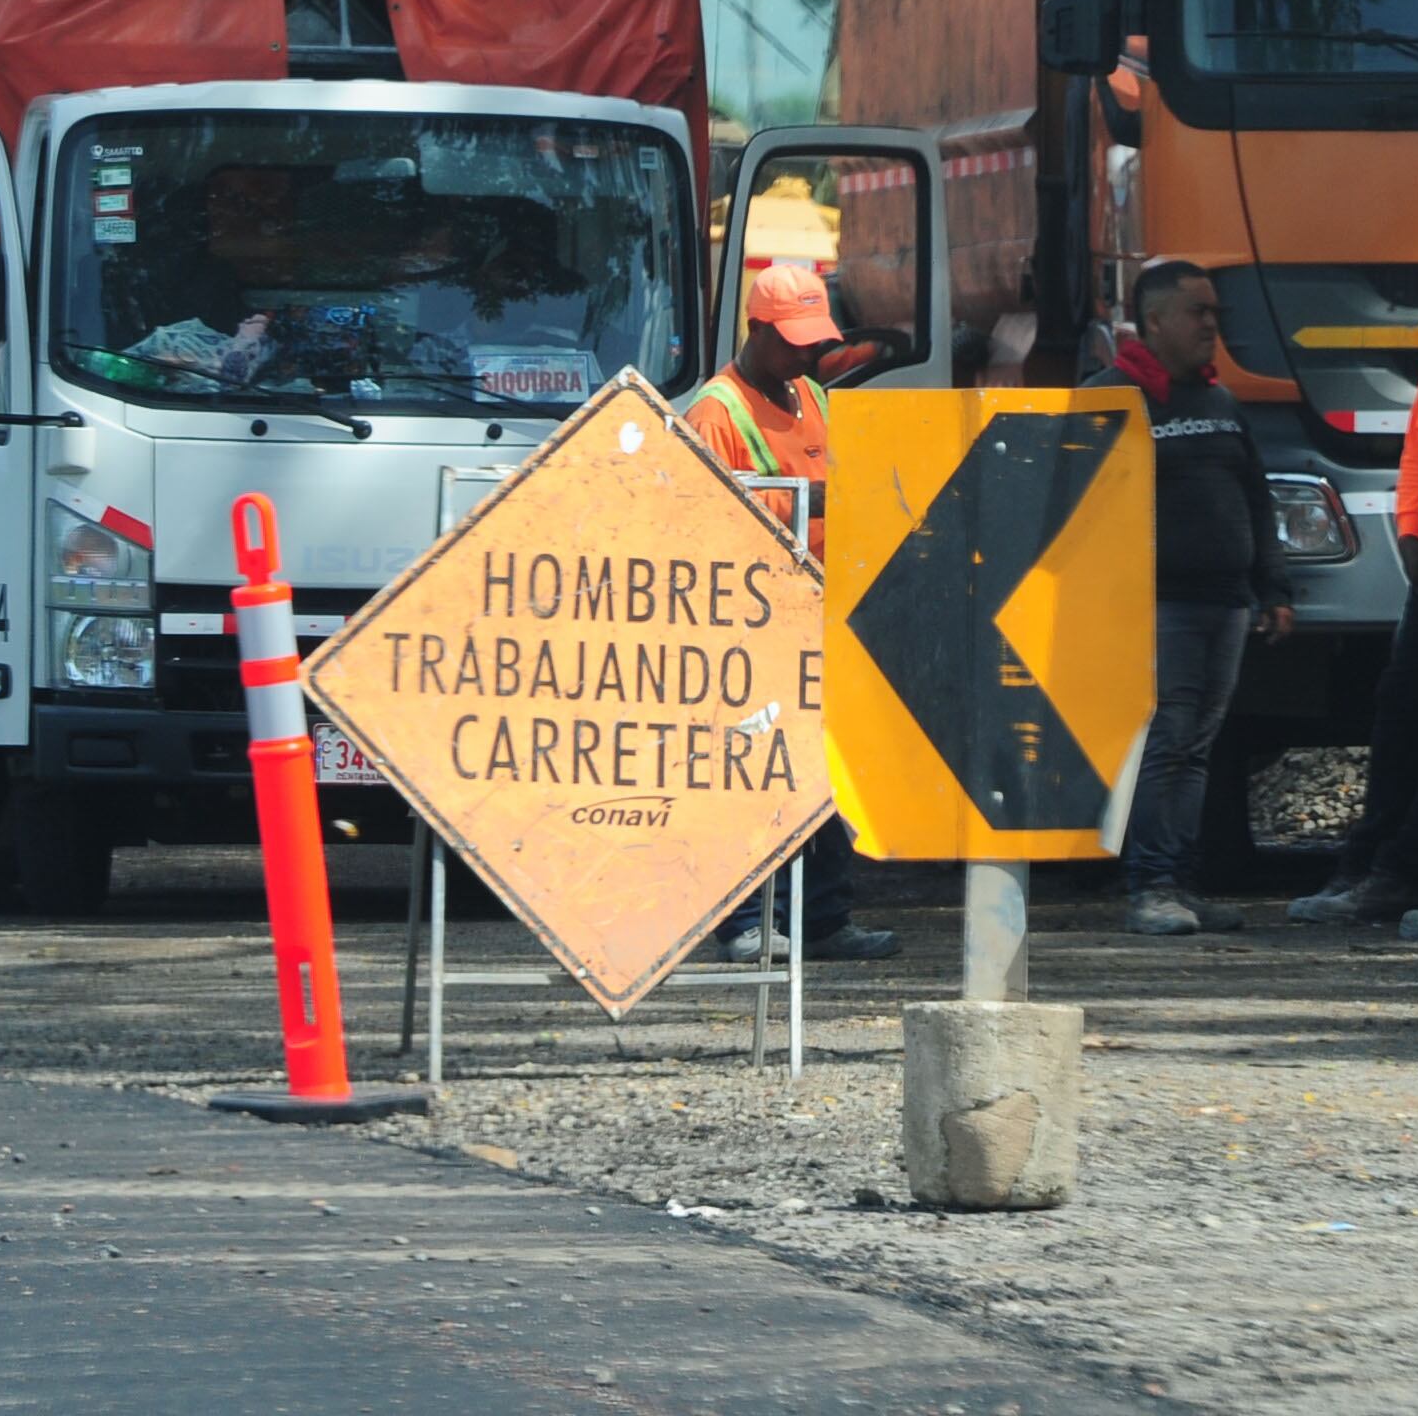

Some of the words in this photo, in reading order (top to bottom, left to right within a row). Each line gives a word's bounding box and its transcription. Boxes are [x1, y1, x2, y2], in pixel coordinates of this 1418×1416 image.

[302, 543, 426, 572] ISUZ
[483, 551, 772, 629] HOMBRES
[383, 632, 753, 709] TRABAJANDO
[335, 739, 377, 770] 34
[451, 714, 797, 792] CARRETERA
[571, 803, 673, 827] conavi
